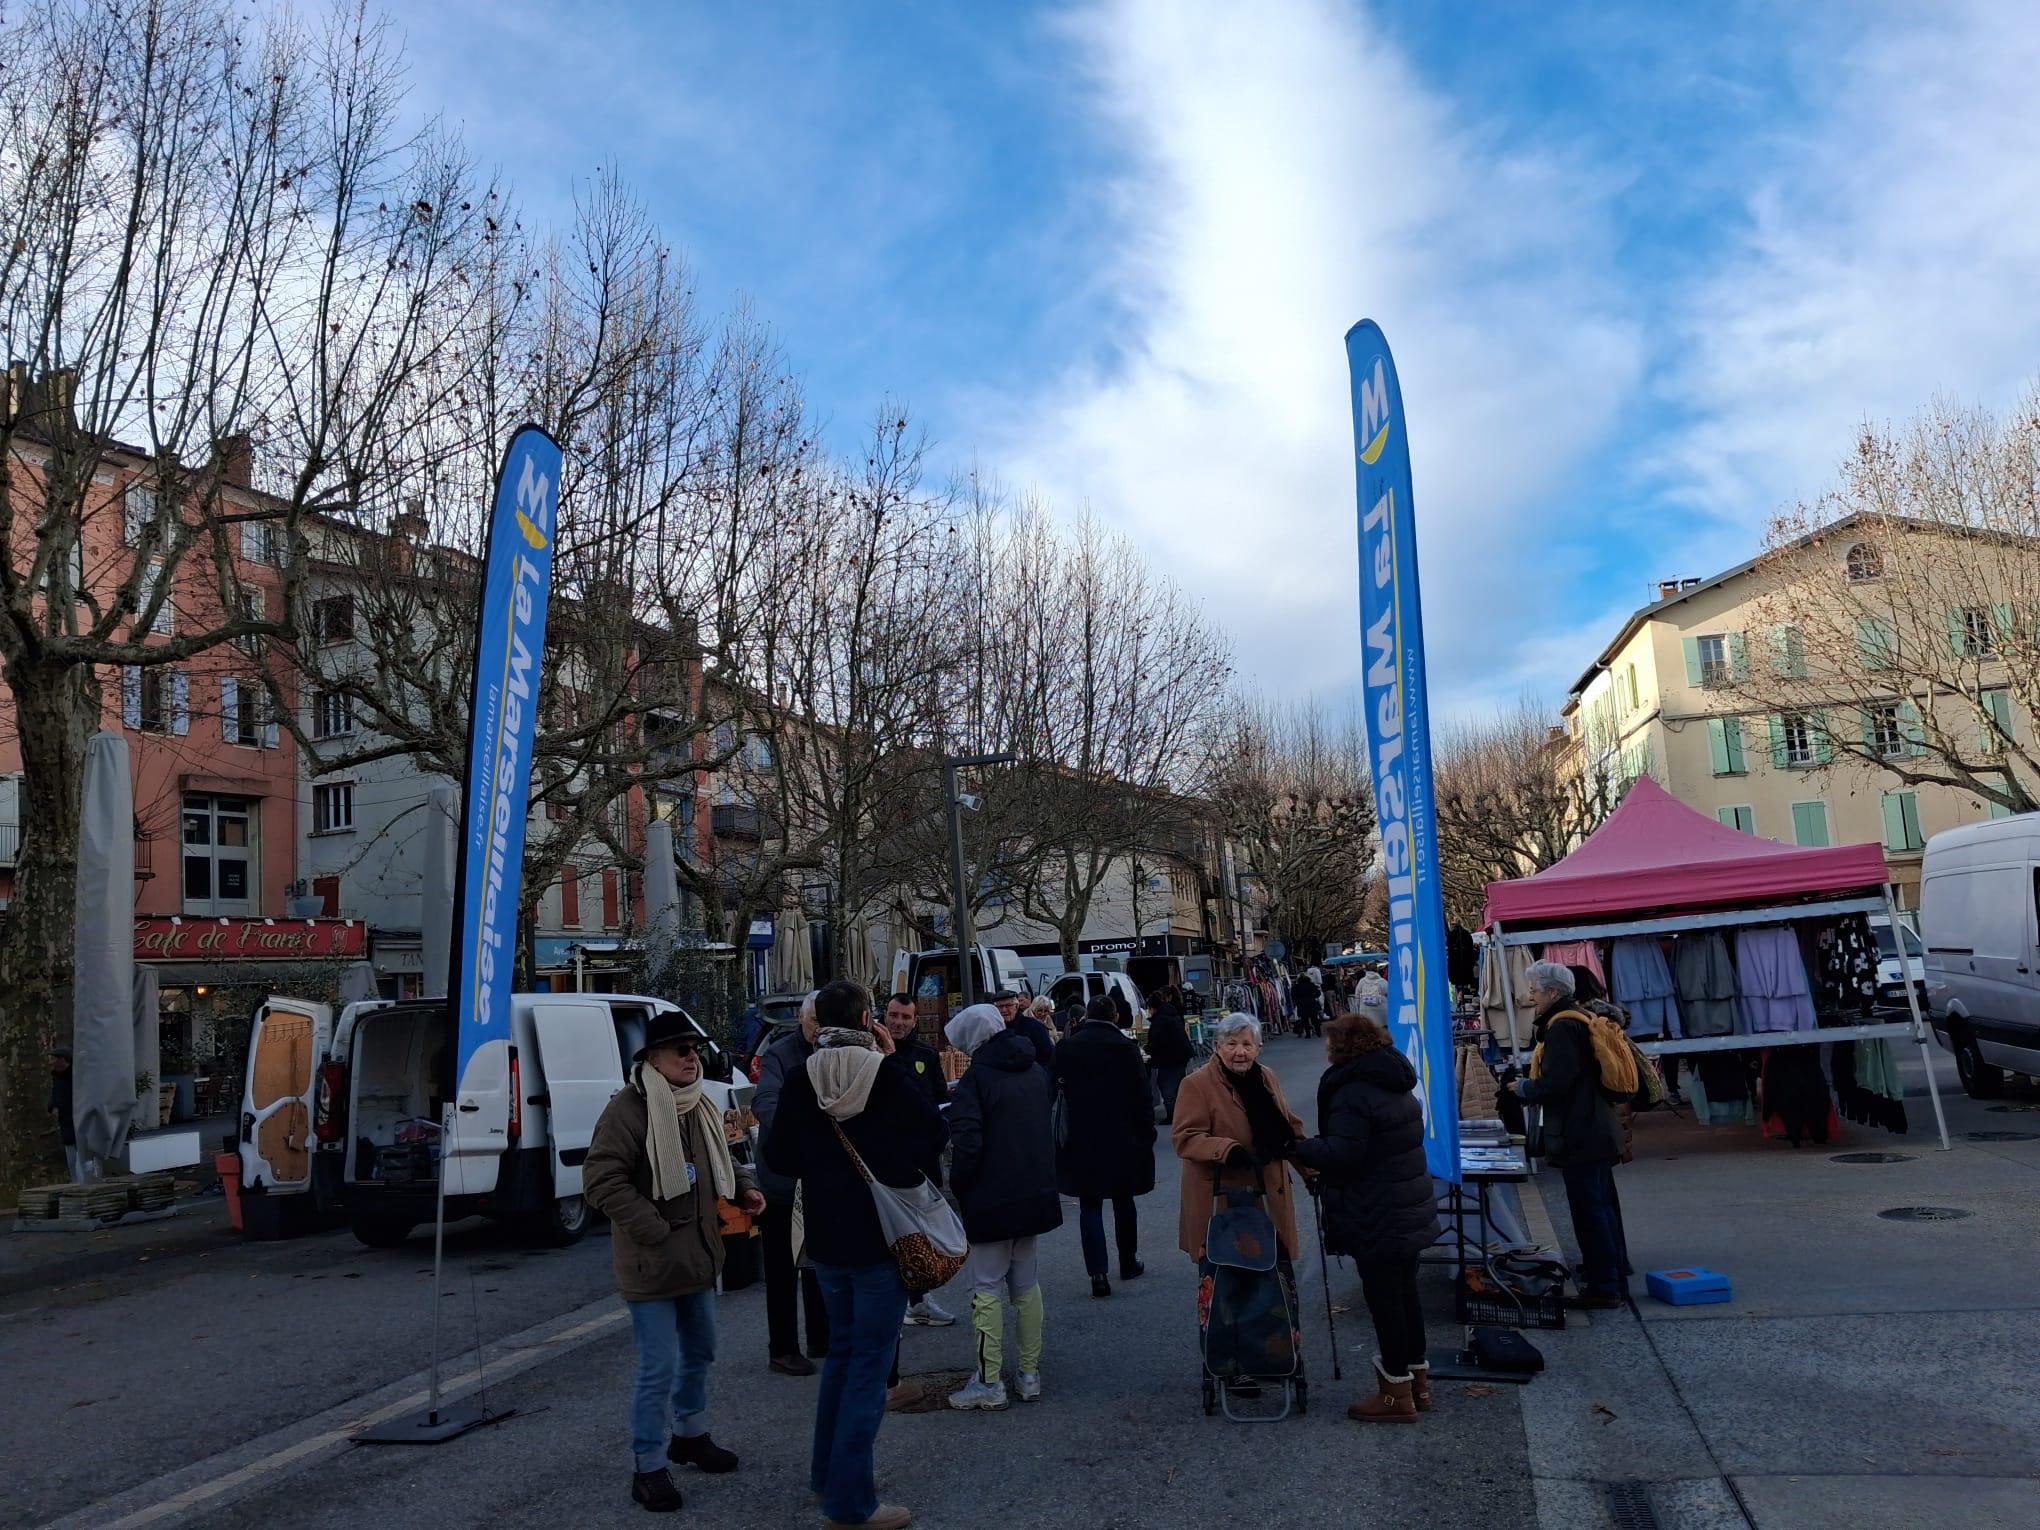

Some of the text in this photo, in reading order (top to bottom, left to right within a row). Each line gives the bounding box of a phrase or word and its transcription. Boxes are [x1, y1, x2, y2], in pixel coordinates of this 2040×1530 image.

[475, 682, 499, 851] lamarseillaise.fr
[479, 553, 540, 1026] La Marseillaise
[198, 923, 228, 950] de
[236, 921, 319, 951] France
